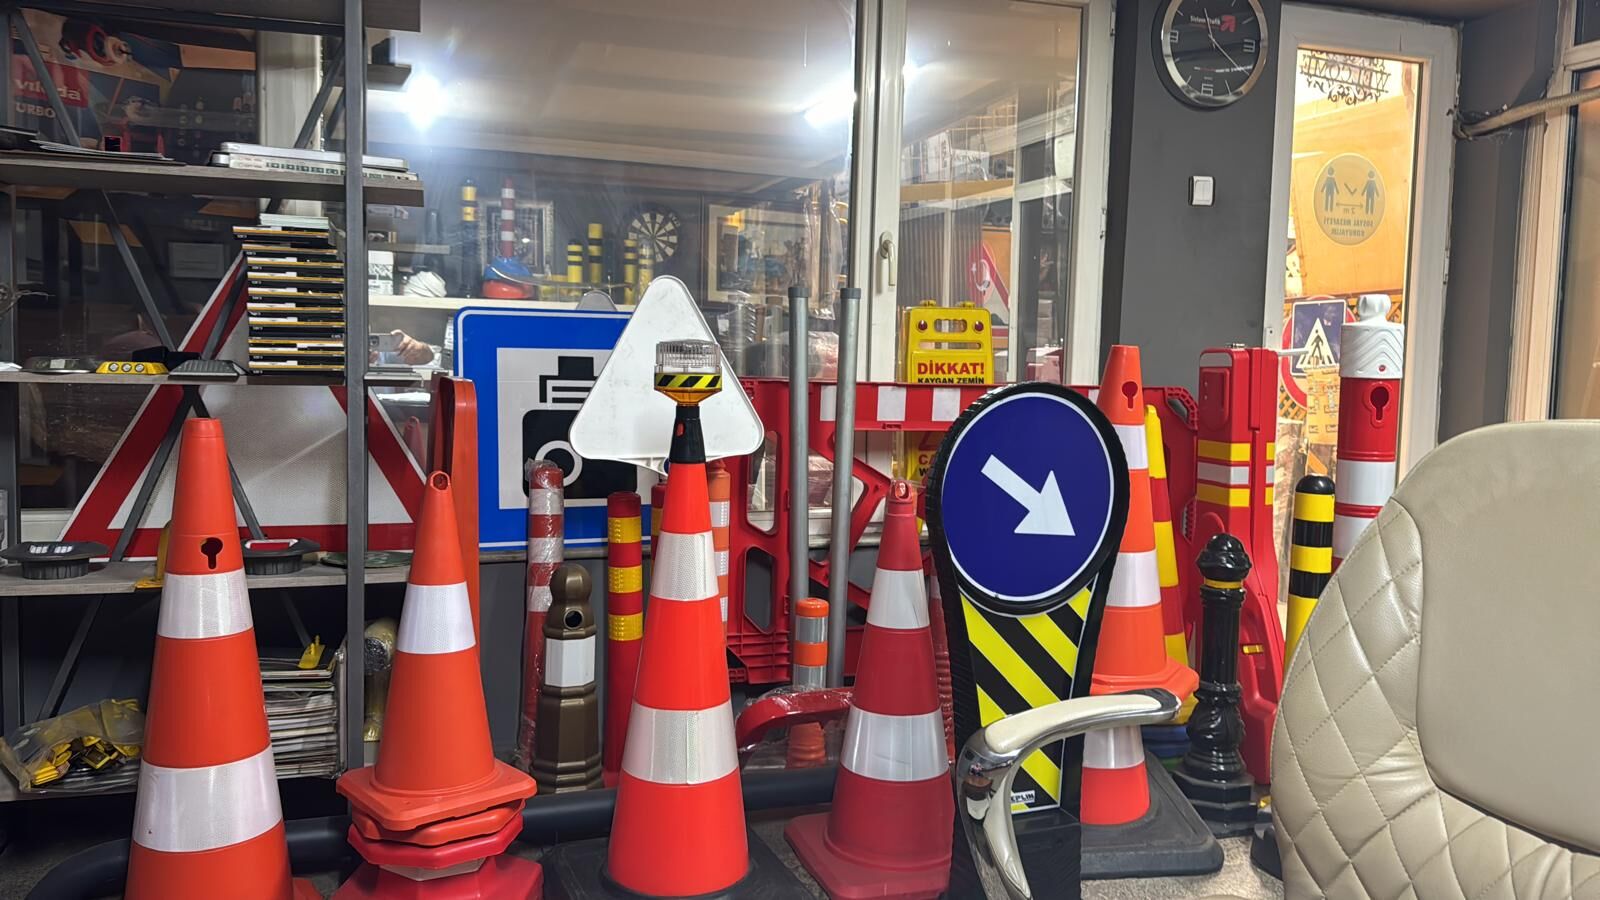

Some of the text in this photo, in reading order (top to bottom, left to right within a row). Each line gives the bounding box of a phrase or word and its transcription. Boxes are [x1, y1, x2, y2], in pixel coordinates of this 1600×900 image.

[1243, 39, 1256, 53] 3
[14, 79, 81, 101] vilda
[1201, 83, 1214, 96] 6
[15, 102, 57, 118] URBO
[917, 359, 985, 375] DİKKAT!
[956, 376, 985, 384] ZEMİN
